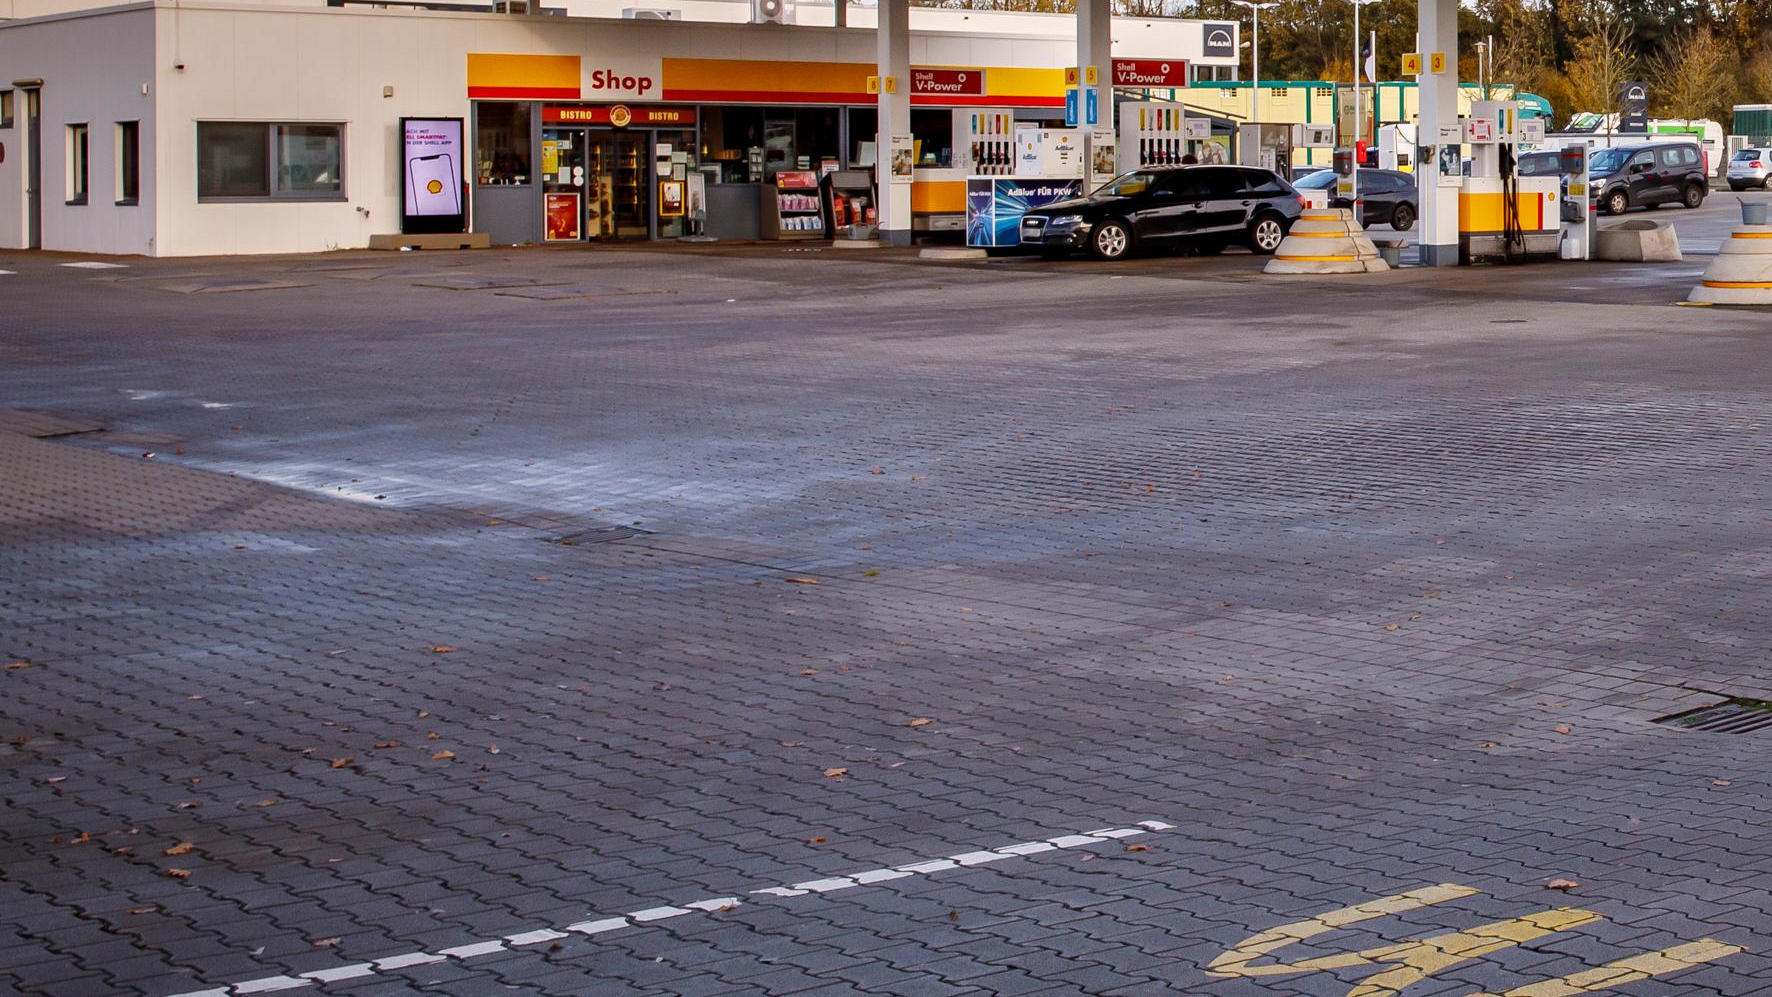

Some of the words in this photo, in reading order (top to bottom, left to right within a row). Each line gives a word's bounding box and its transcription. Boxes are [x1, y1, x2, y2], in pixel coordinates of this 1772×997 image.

[1116, 62, 1136, 71] Shell
[1407, 58, 1416, 70] 4
[1434, 57, 1441, 69] 3
[915, 72, 934, 81] Shell
[1069, 70, 1075, 81] 6
[1088, 69, 1094, 80] 5
[1118, 72, 1166, 84] V-Power
[591, 69, 653, 96] Shop
[915, 80, 963, 92] V-Power
[560, 110, 592, 120] BISTRO
[648, 111, 679, 121] BISTRO
[1037, 186, 1052, 196] FÜR
[1053, 188, 1072, 196] PKW
